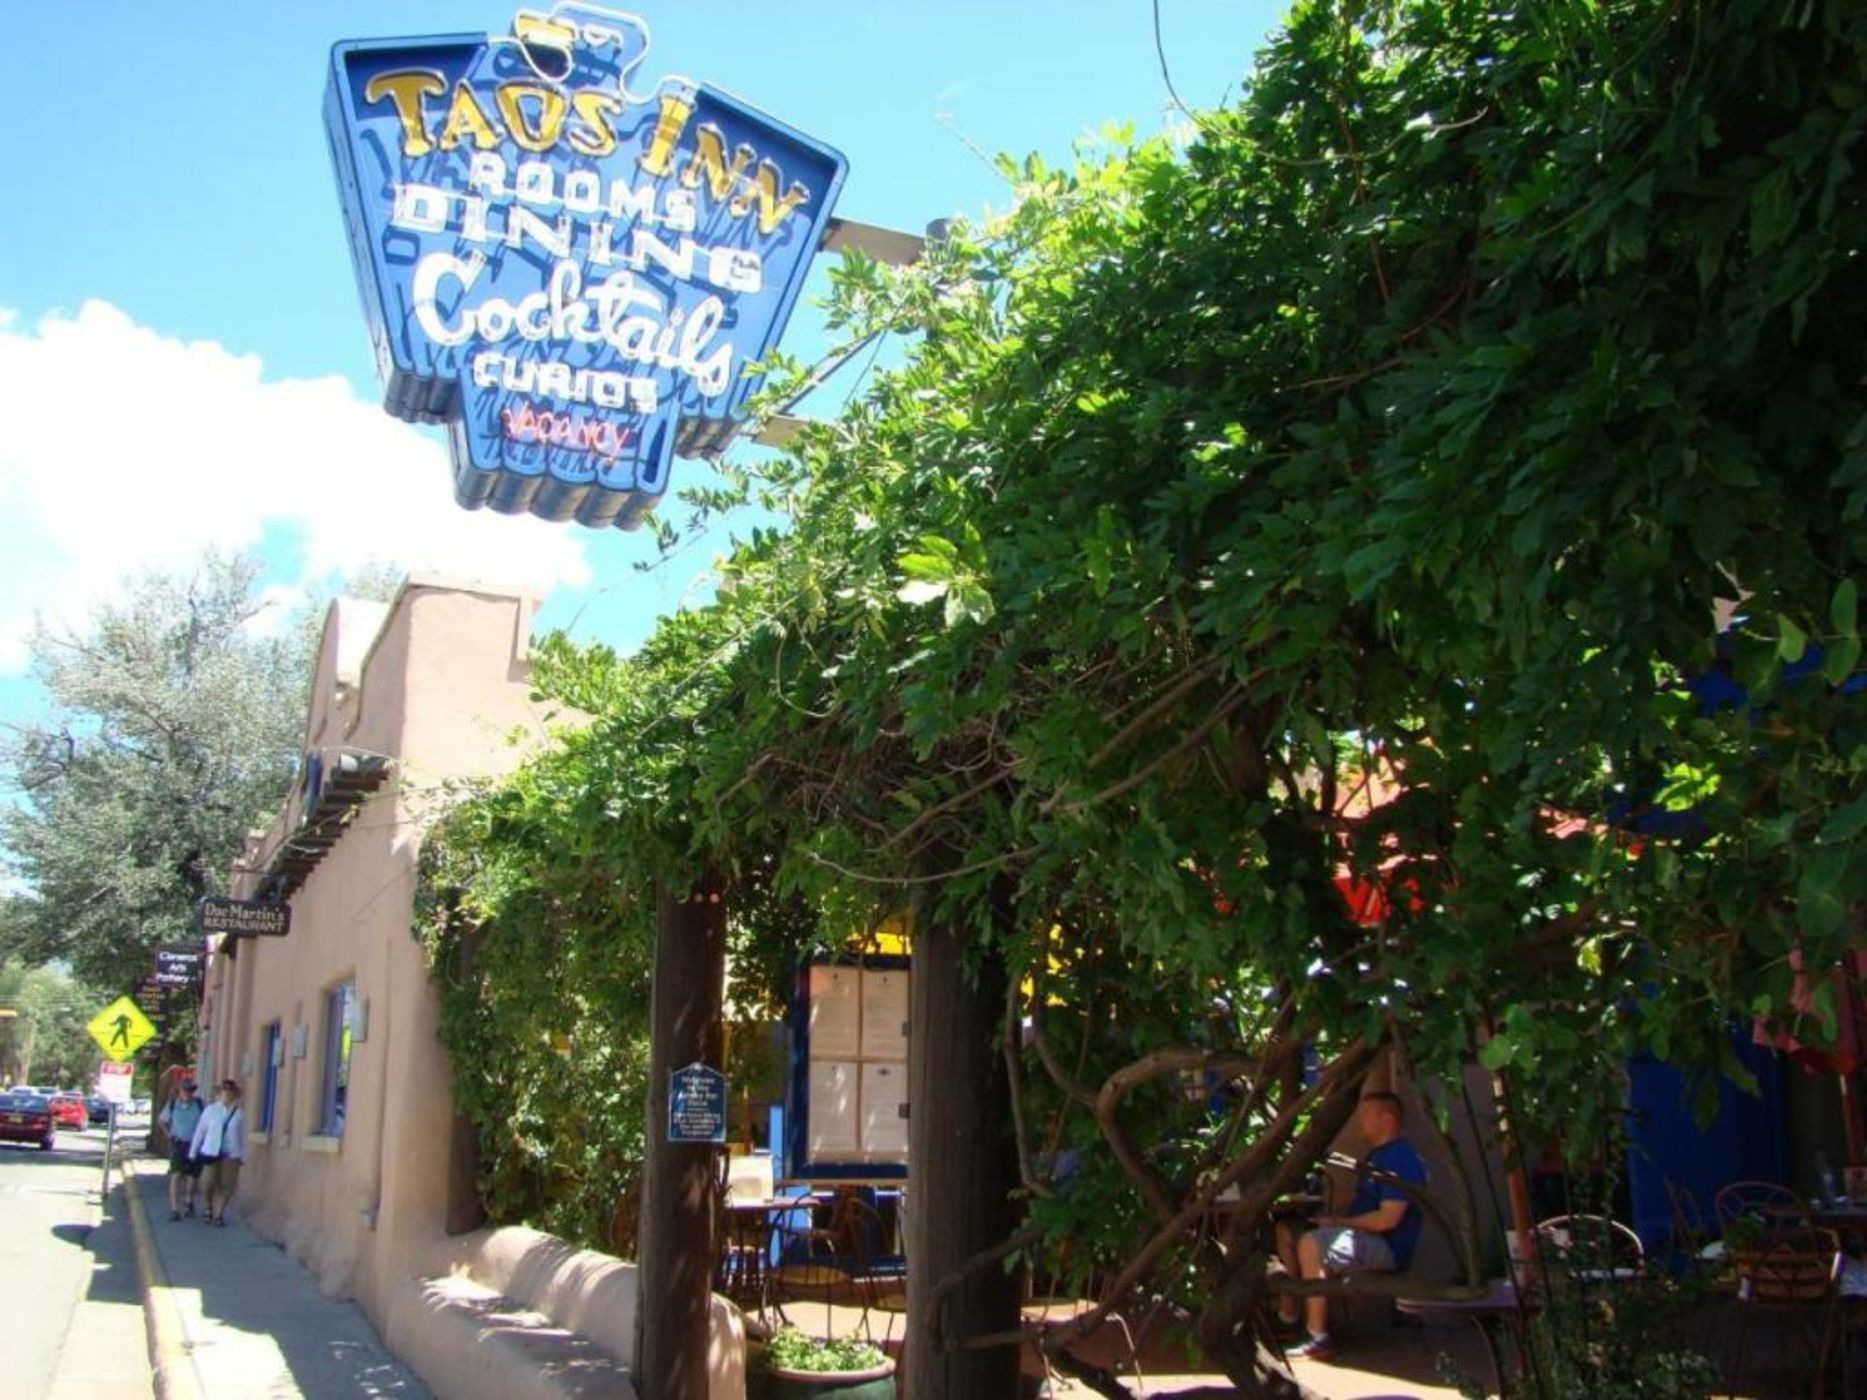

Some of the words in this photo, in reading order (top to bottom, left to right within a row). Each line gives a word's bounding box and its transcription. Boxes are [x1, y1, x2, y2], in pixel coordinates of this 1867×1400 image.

[365, 67, 624, 157] TAOS
[469, 151, 697, 232] ROOMS
[392, 181, 763, 294] DINING
[412, 249, 733, 397] Cocktails
[473, 352, 657, 414] CURIOS
[203, 917, 284, 932] RESTAURANT
